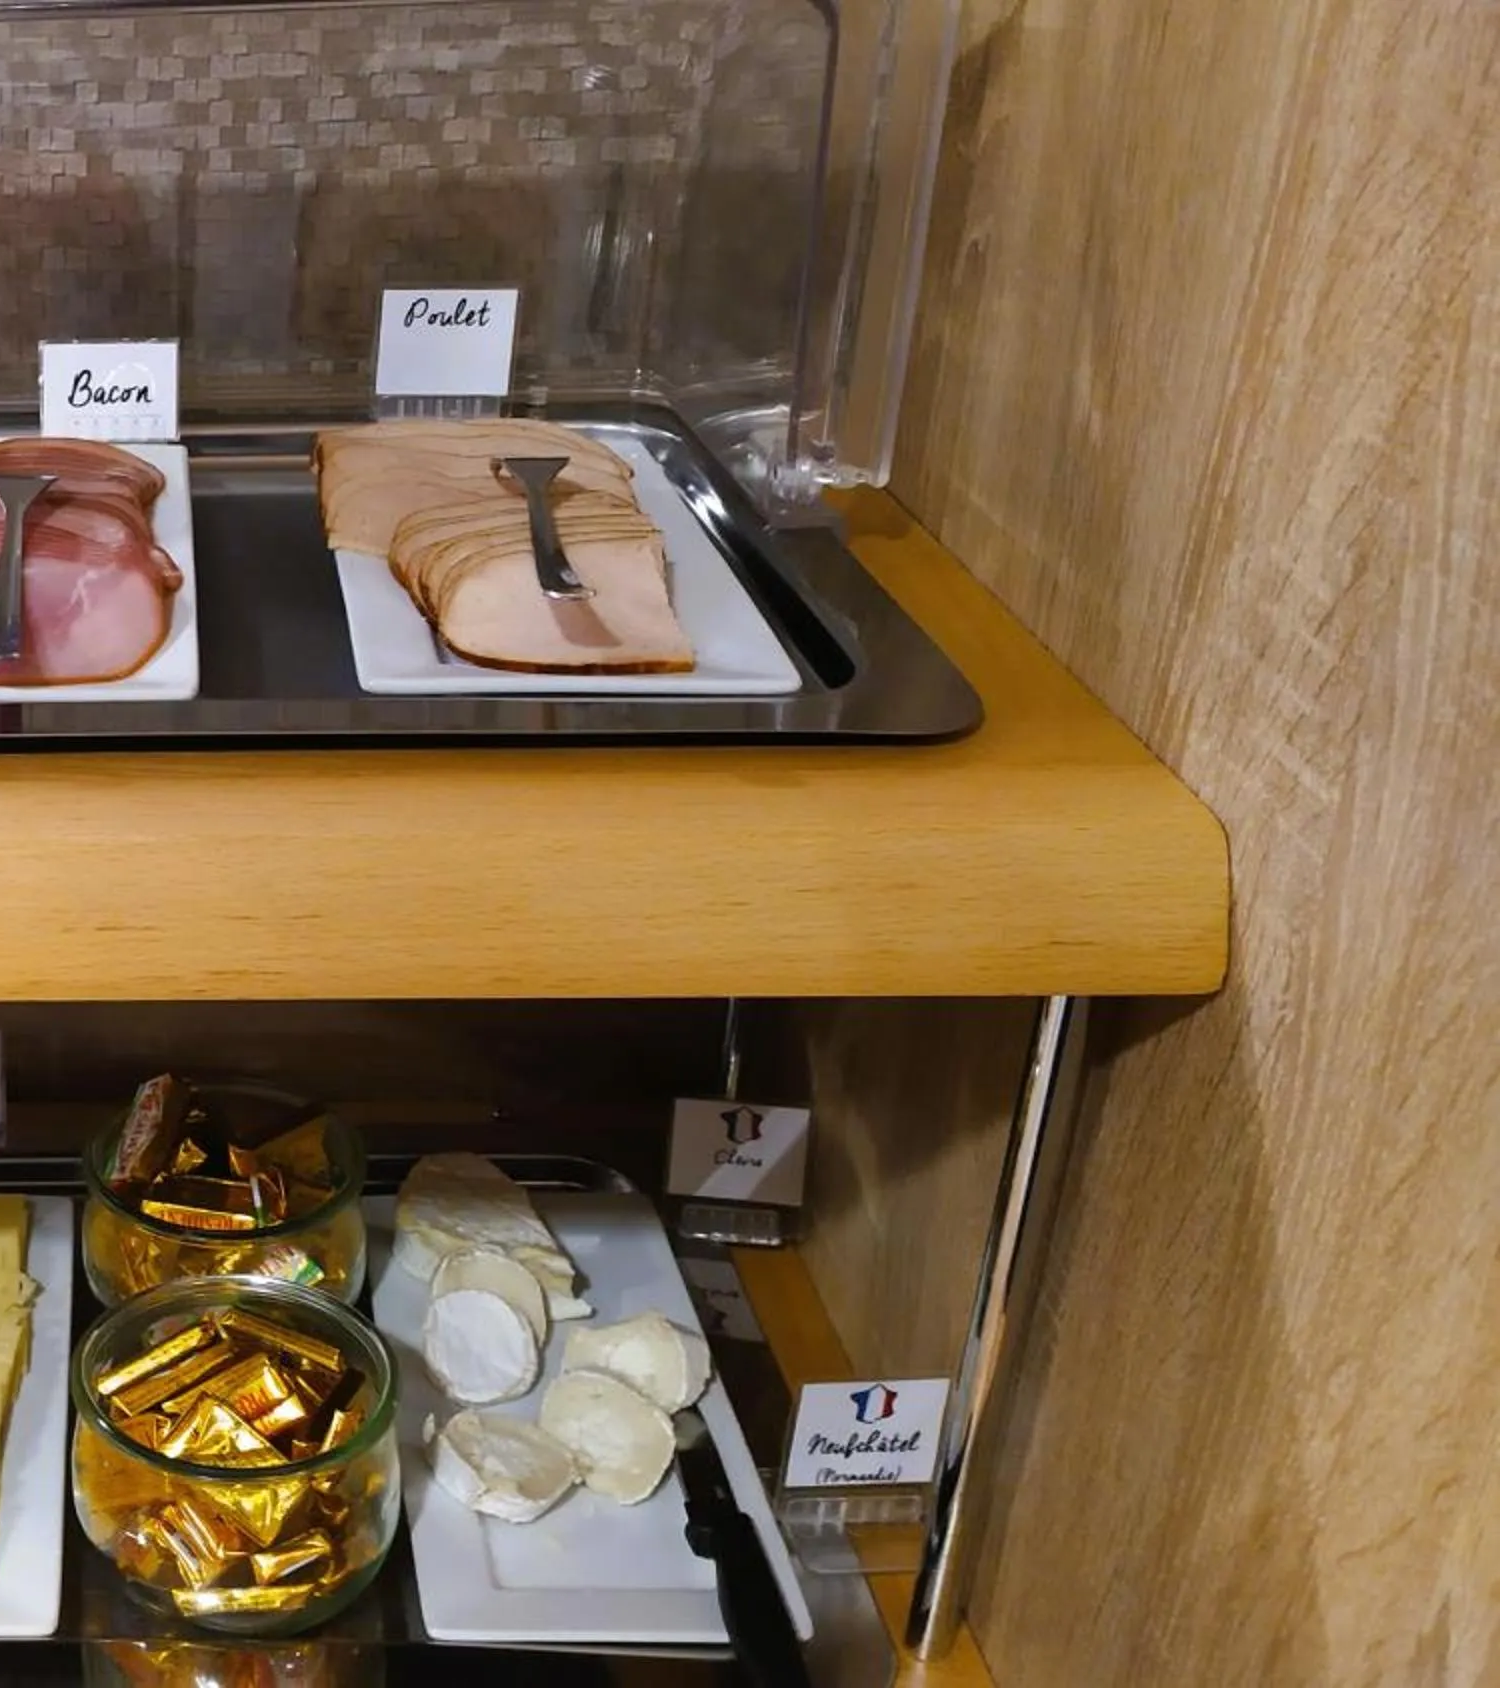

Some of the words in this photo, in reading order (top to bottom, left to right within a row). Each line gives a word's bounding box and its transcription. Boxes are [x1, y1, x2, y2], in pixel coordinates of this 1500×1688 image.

[404, 297, 491, 327] Poulet
[67, 368, 153, 408] Bacon
[807, 1429, 922, 1459] Neufchâtel
